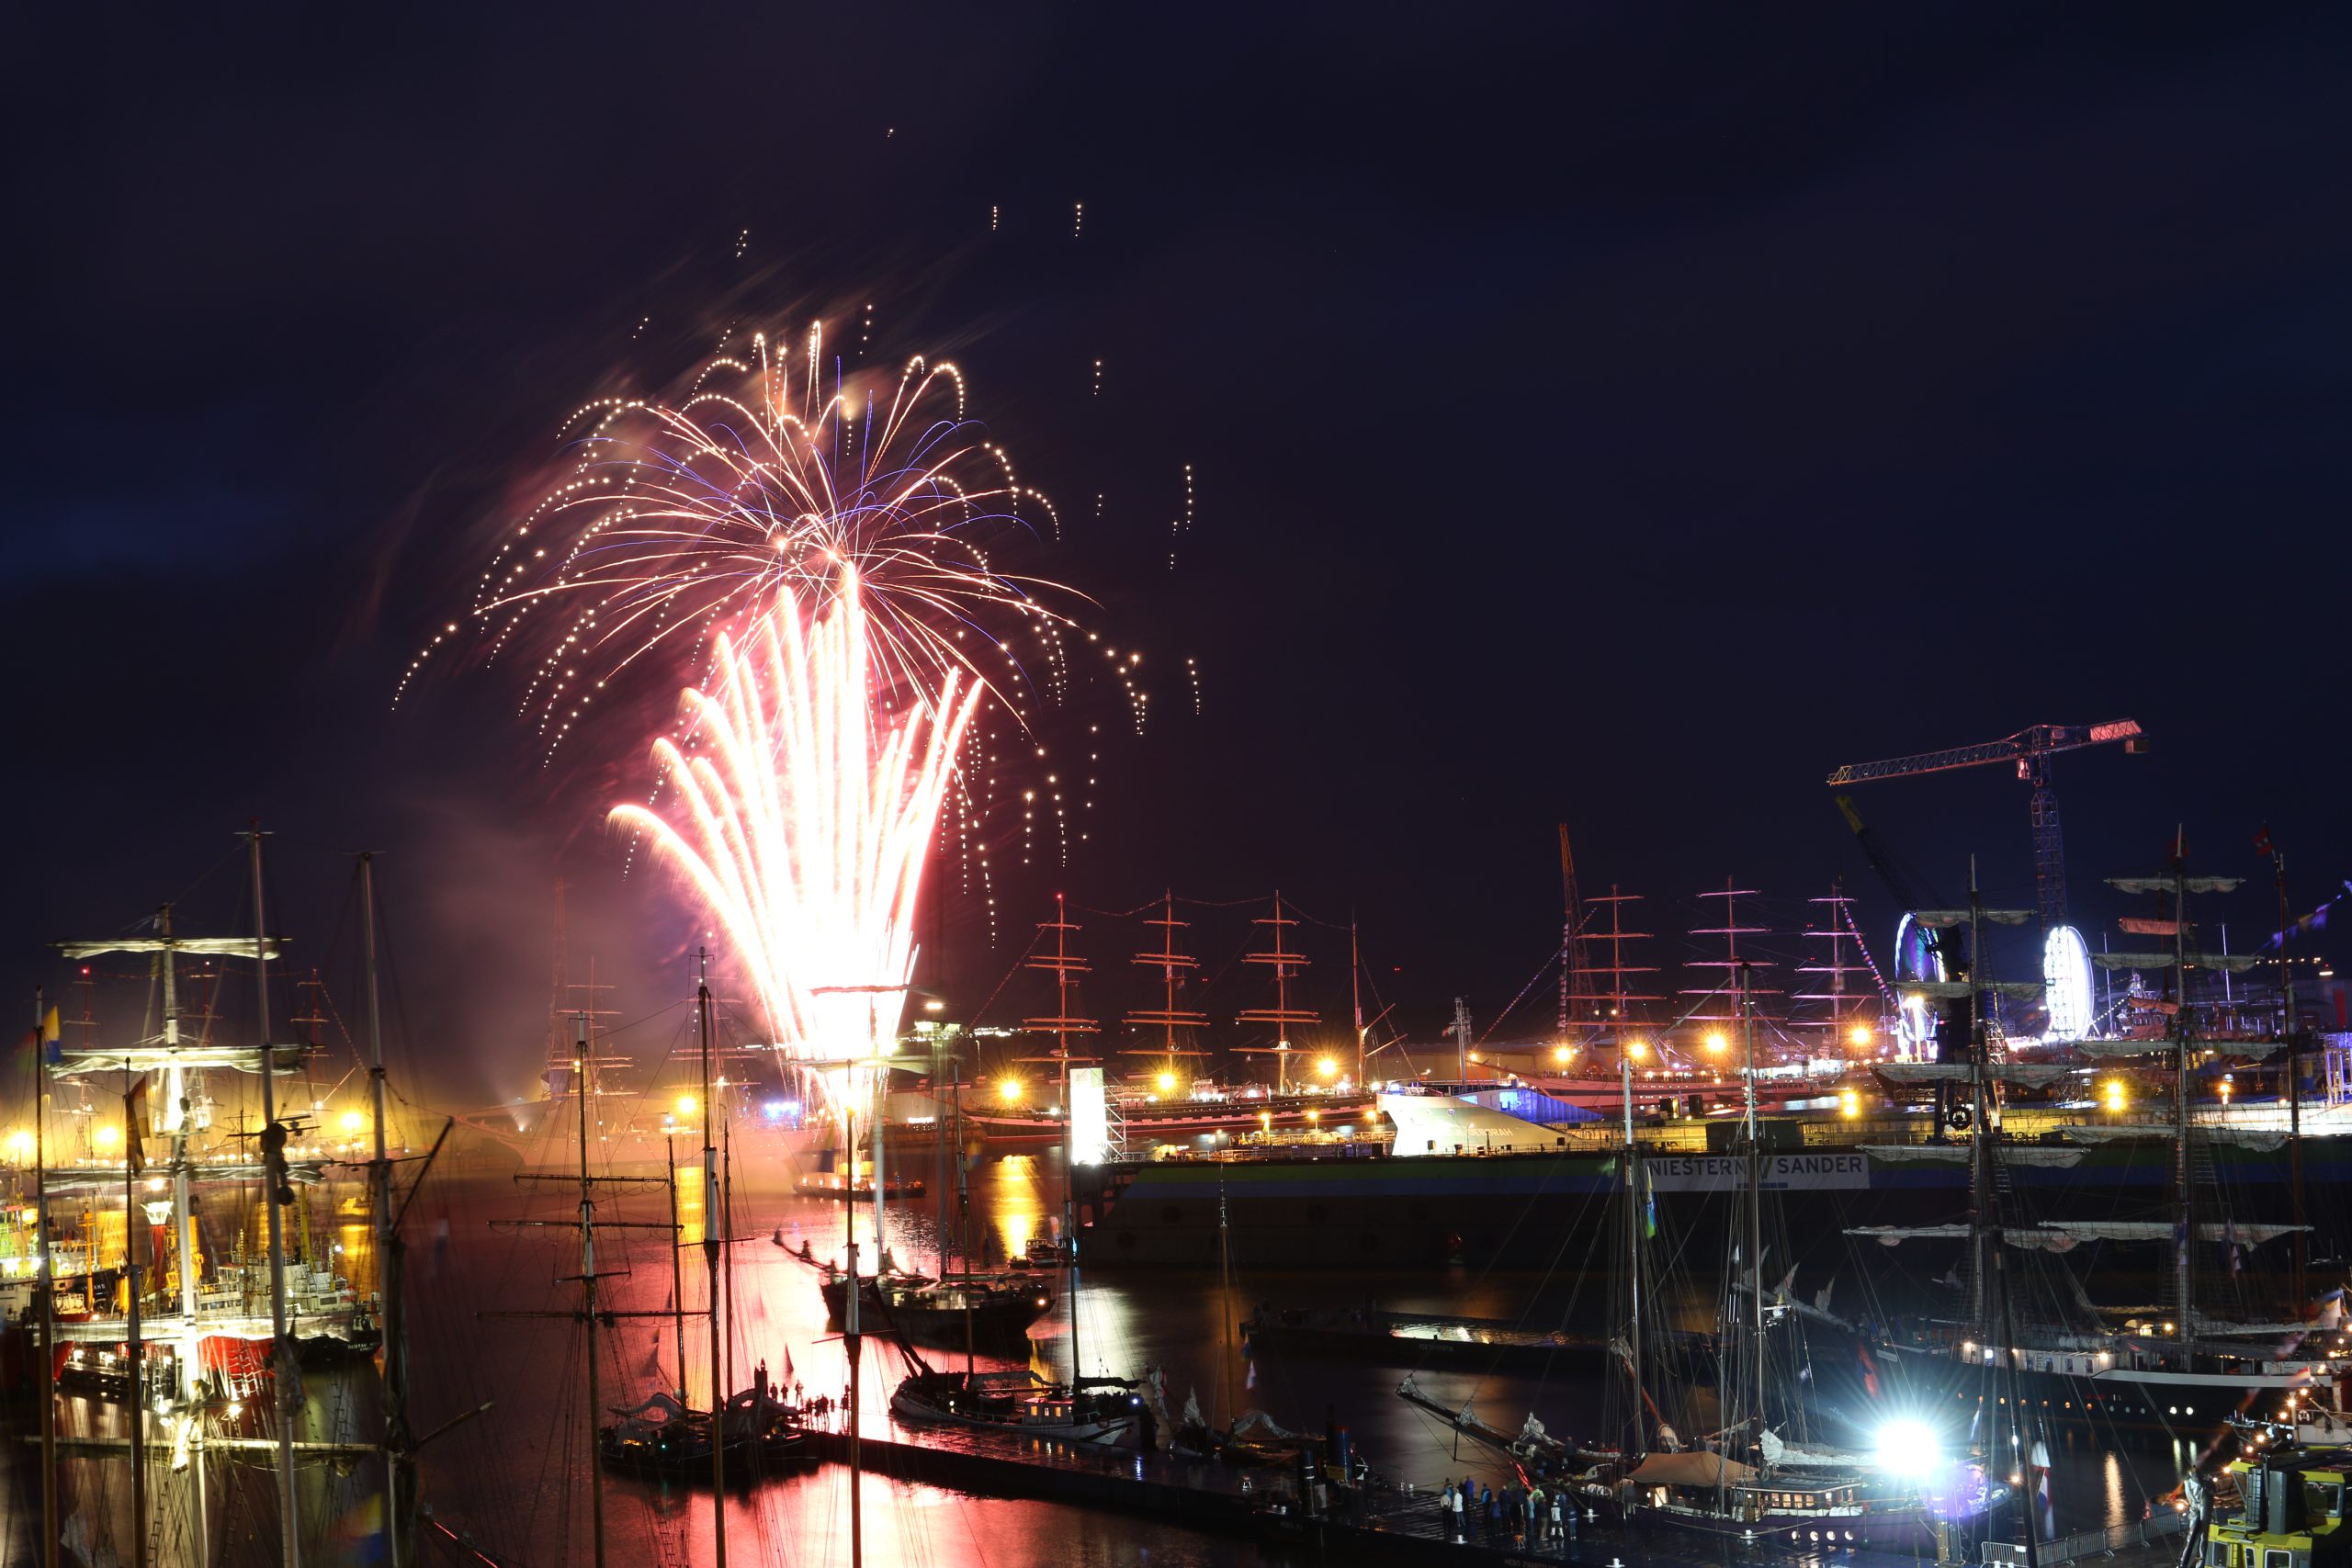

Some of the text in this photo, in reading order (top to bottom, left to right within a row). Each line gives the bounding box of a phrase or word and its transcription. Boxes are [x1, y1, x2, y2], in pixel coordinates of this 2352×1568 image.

[1107, 1085, 1147, 1093] GENBORG
[1649, 1156, 1863, 1177] NIESTERN SANDER
